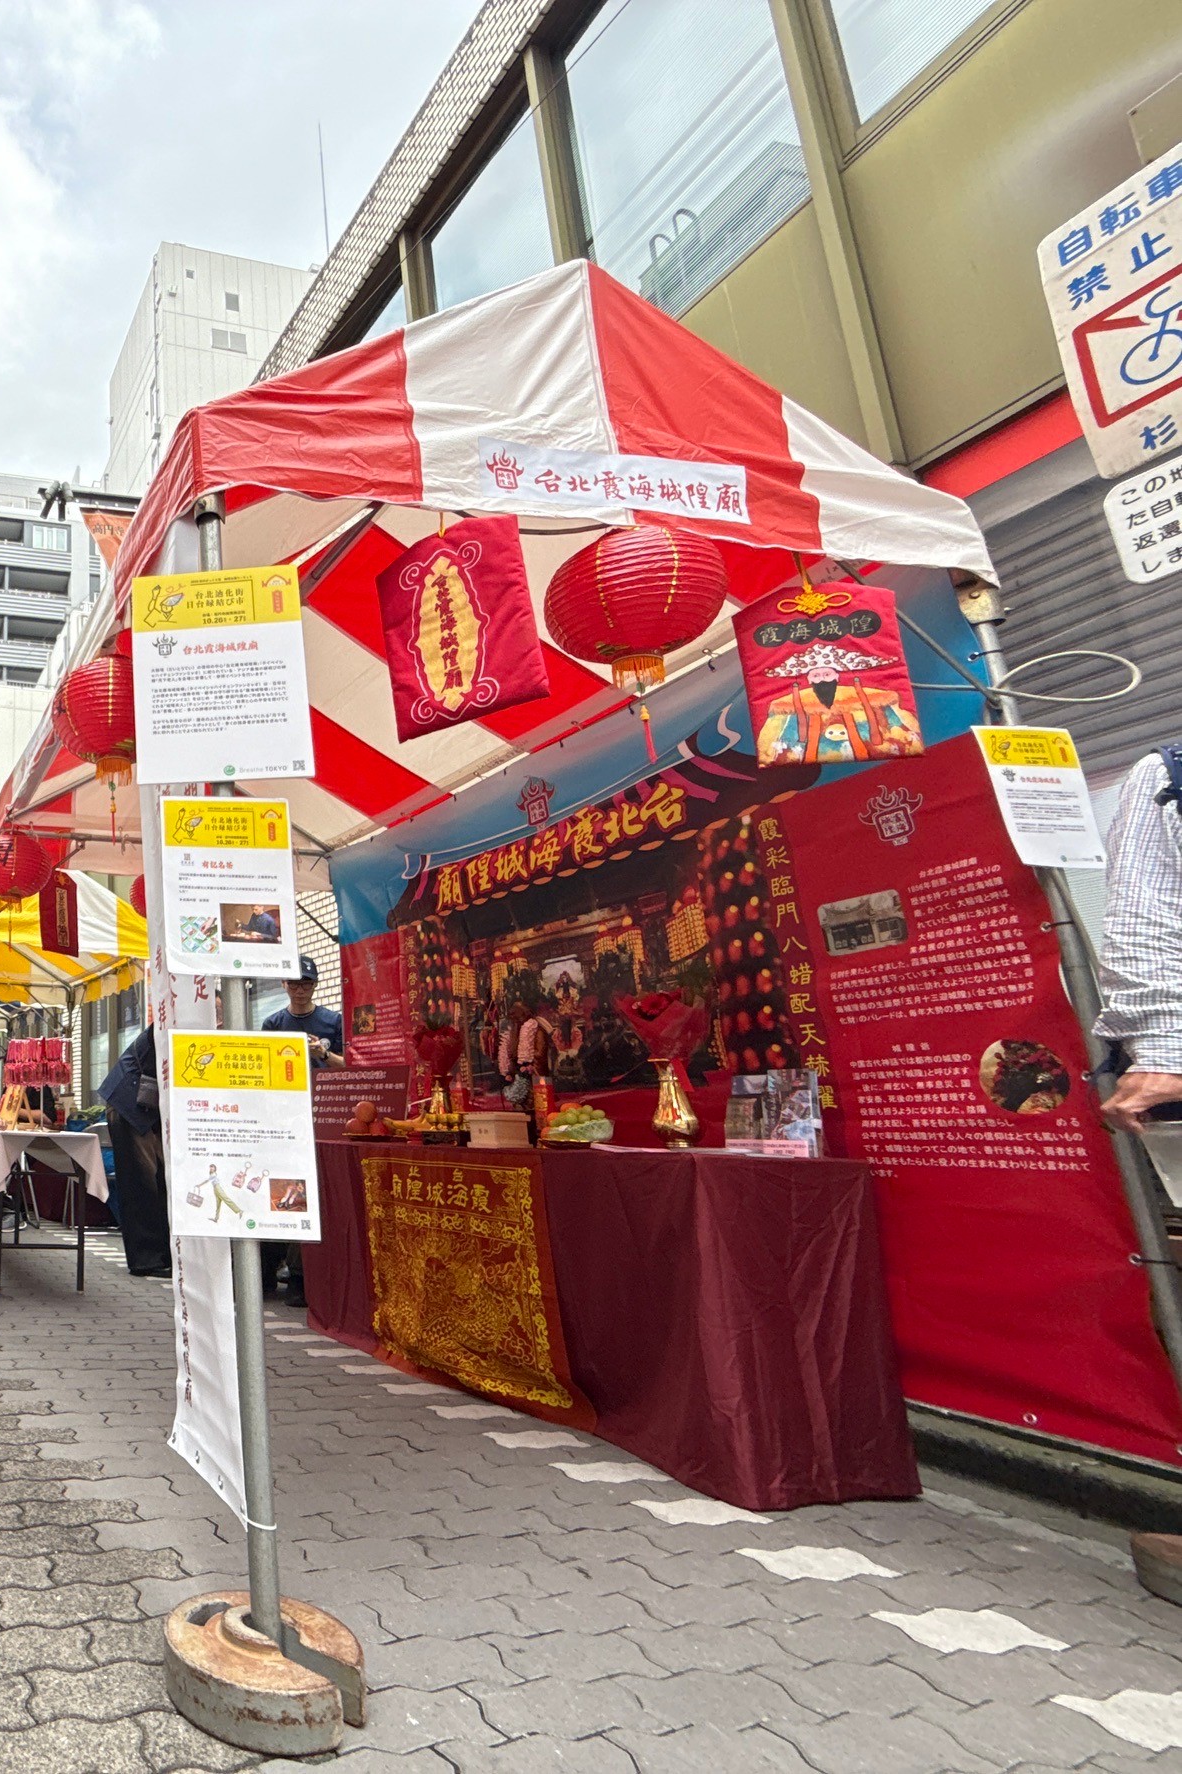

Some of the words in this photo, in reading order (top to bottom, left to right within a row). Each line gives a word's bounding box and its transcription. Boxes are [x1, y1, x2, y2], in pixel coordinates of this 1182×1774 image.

[1057, 158, 1182, 267] 自転車
[1066, 232, 1173, 311] 禁止
[1139, 414, 1178, 450] 杉
[534, 468, 744, 516] 台北霞海城隍廟
[759, 614, 875, 645] 霞海城隍
[183, 640, 259, 655] 台北霞海城隍廟
[265, 765, 288, 773] TOKYO
[435, 782, 687, 912] 台北霞海城隍廟
[202, 860, 234, 869] 有記名茶
[212, 1104, 239, 1114] 小花園
